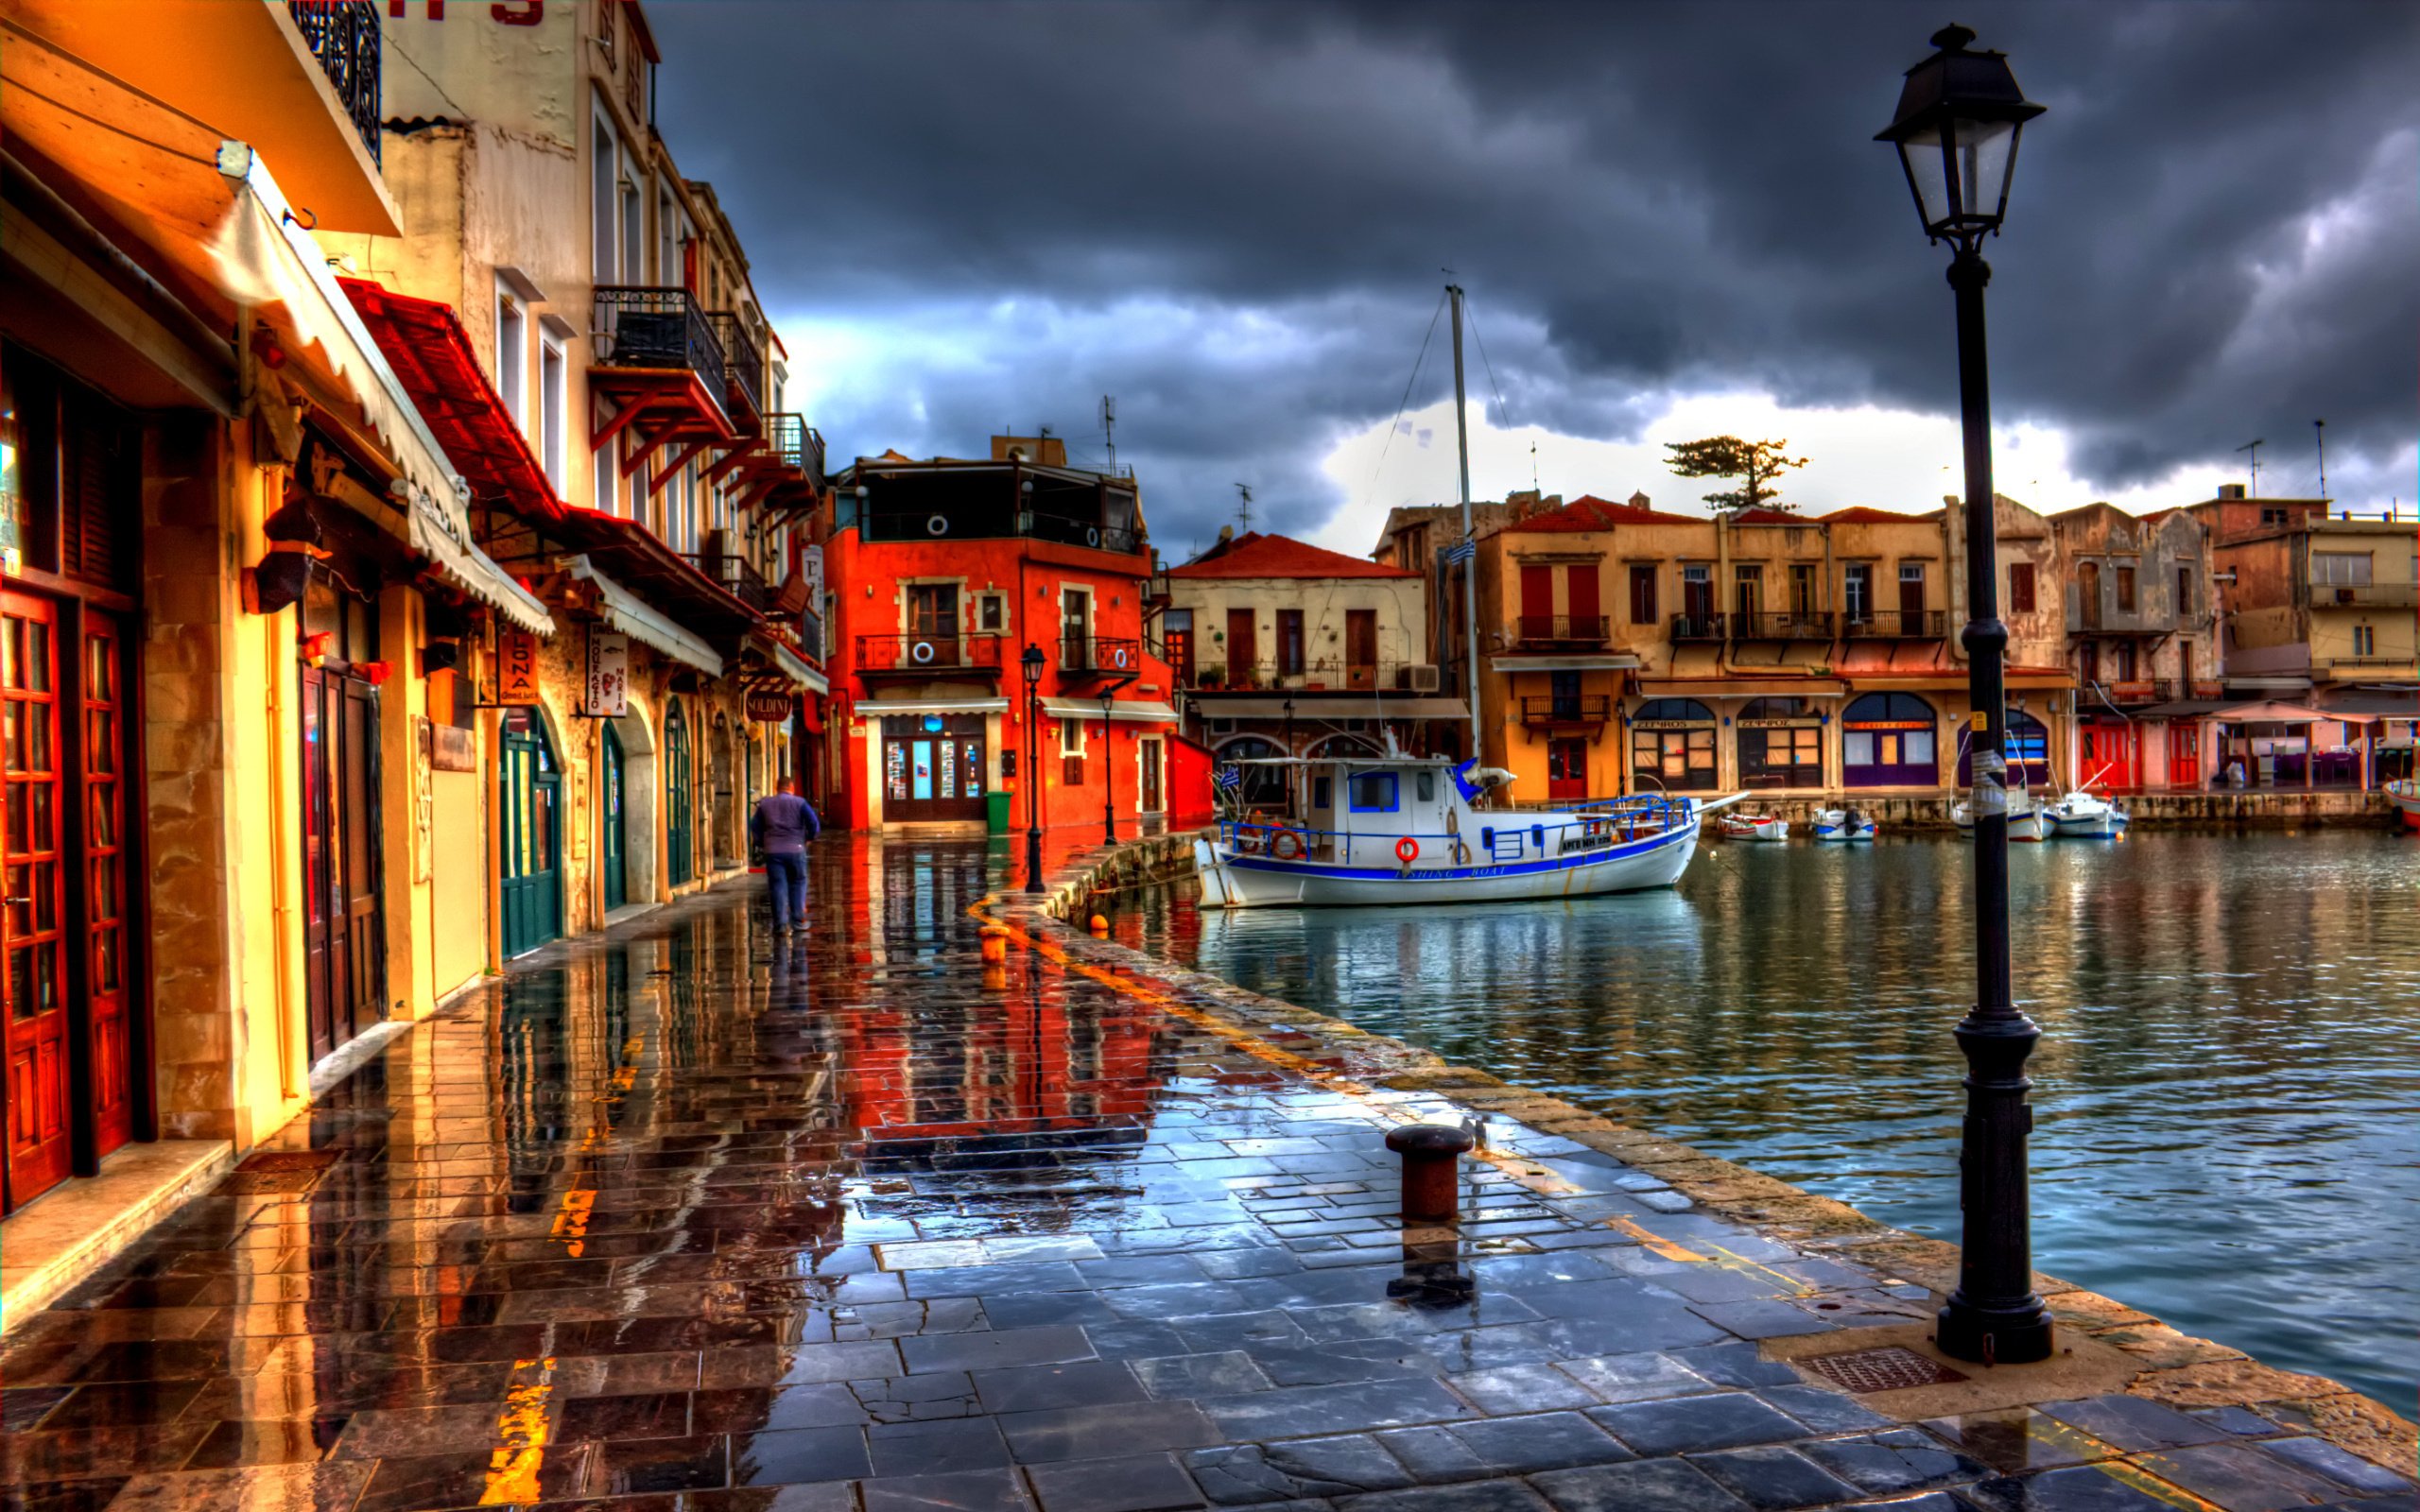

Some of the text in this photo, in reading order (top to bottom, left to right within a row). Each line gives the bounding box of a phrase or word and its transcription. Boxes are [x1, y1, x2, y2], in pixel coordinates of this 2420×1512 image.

[591, 637, 600, 710] MOURAGIO
[748, 698, 788, 713] SOLDINI
[1395, 865, 1508, 880] FSHING BOAT
